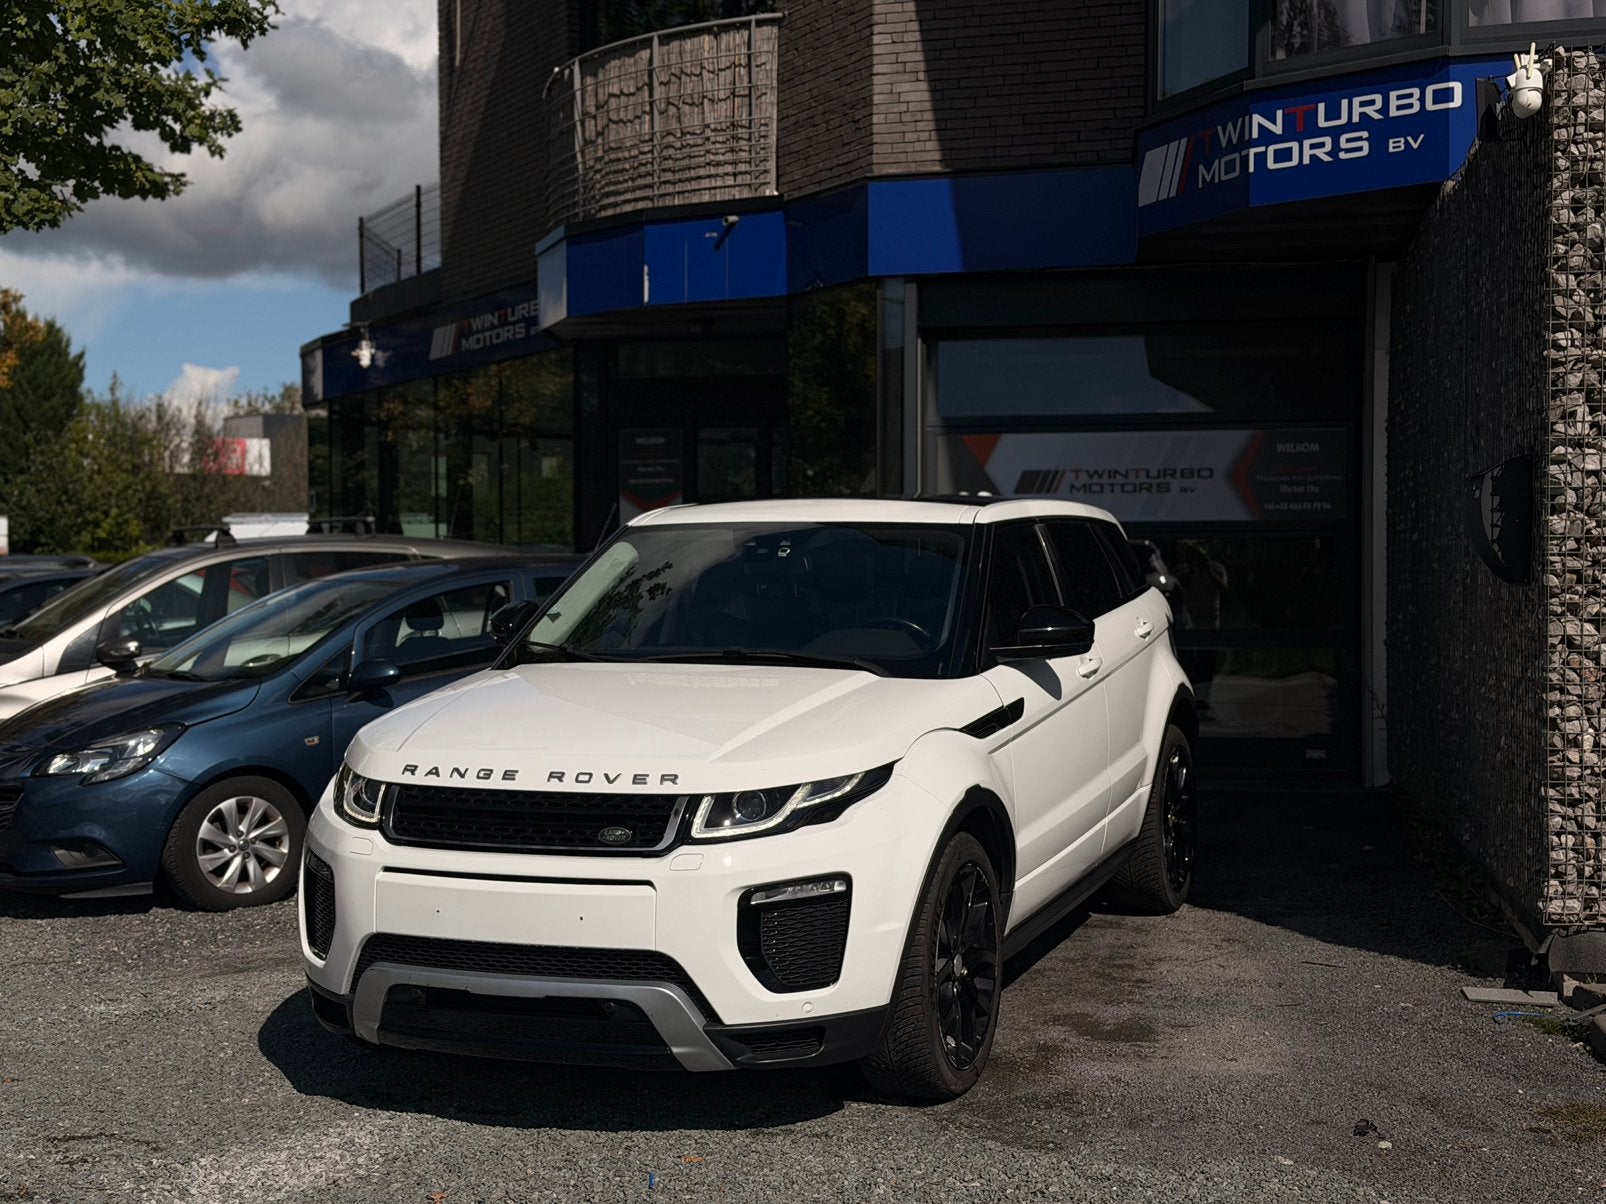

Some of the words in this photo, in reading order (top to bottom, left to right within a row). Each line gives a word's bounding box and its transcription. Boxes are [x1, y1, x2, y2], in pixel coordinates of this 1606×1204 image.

[1199, 81, 1463, 155] TWINTURBO
[1198, 130, 1369, 189] MOTORS
[1388, 133, 1425, 153] BV
[461, 322, 526, 353] MOTORS
[1276, 442, 1319, 453] WELKOM
[1068, 468, 1214, 480] TWINTURBO
[1069, 482, 1171, 493] MOTORS
[401, 764, 519, 781] RANGE
[547, 771, 680, 786] ROVER
